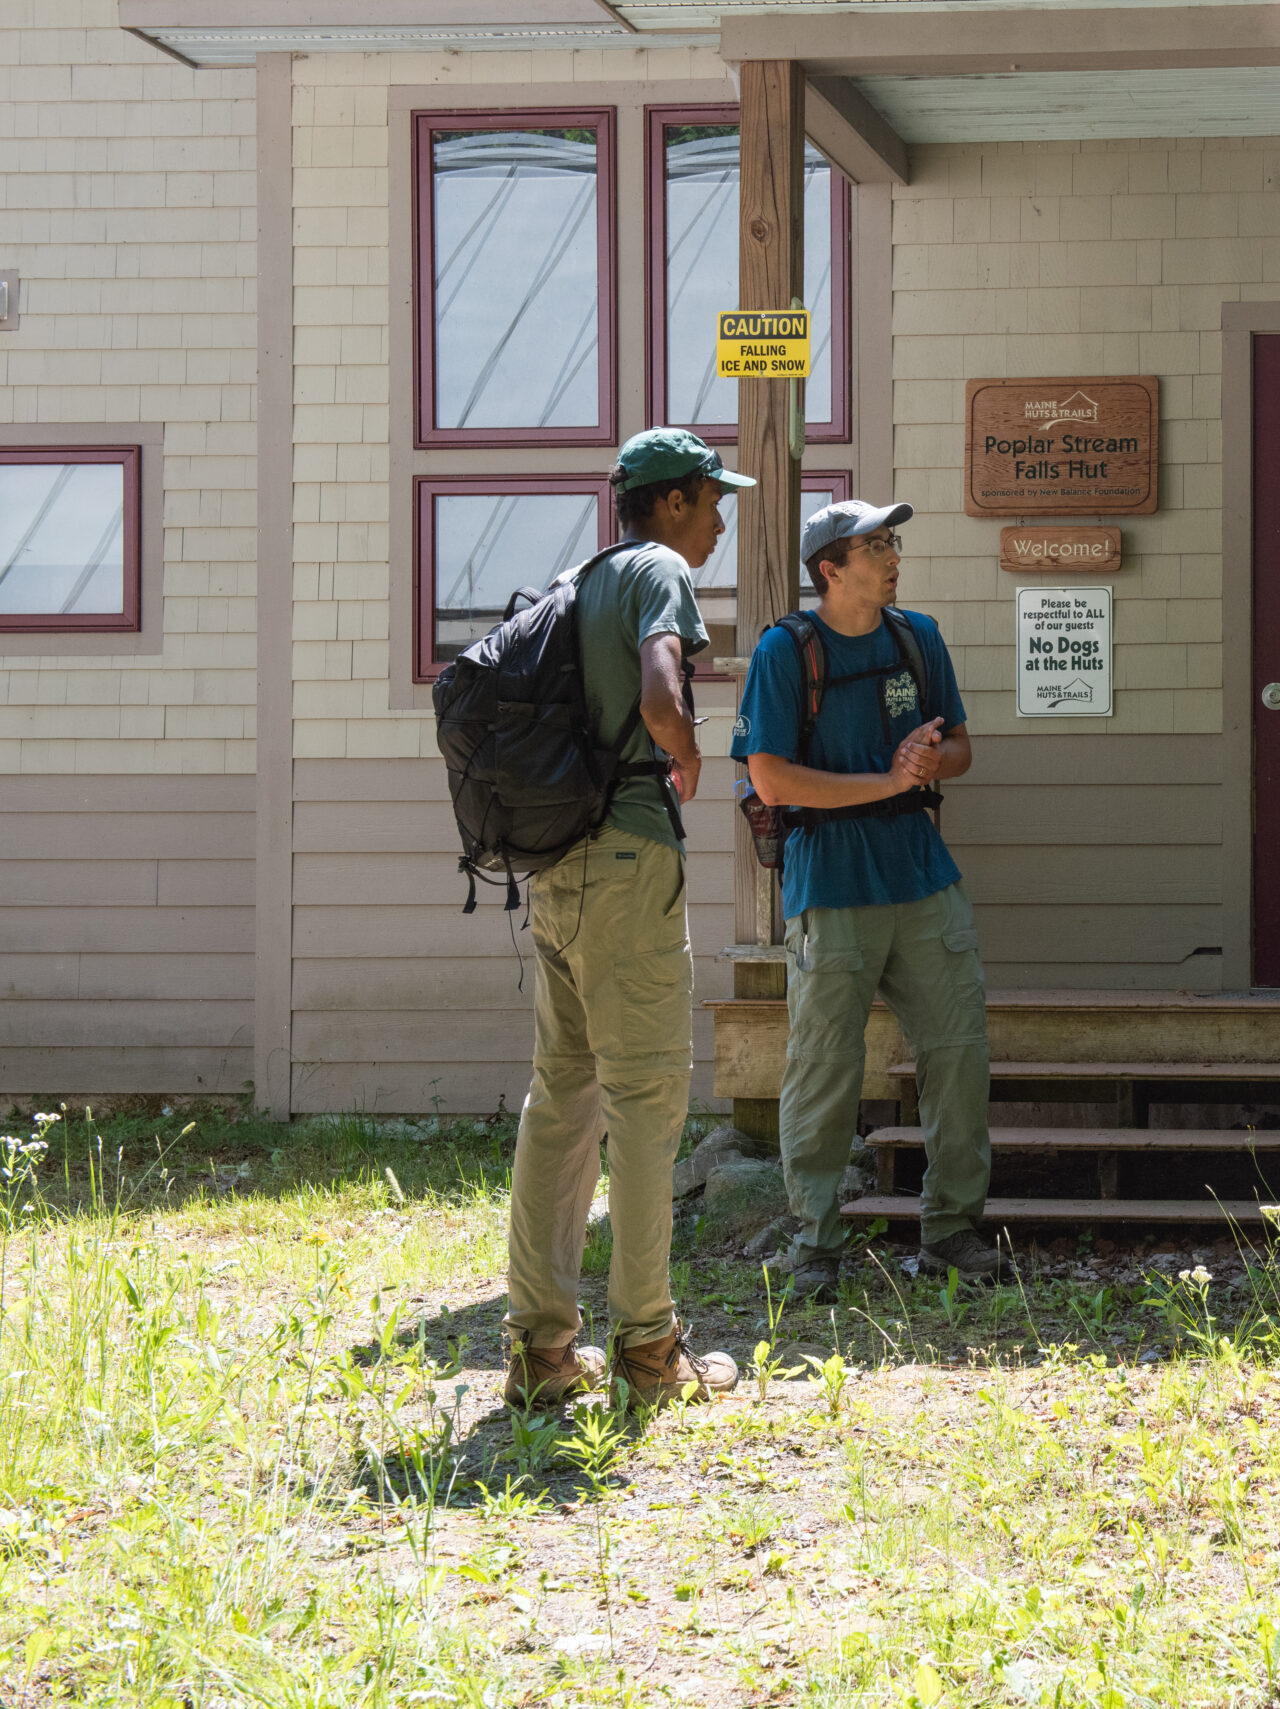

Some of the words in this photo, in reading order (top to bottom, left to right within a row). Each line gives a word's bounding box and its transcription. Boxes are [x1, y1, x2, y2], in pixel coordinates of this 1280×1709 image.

[723, 318, 804, 336] CAUTION
[740, 345, 786, 356] FALLING
[721, 360, 740, 371] ICE
[743, 360, 767, 371] AND
[771, 360, 805, 371] SNOW
[1025, 401, 1057, 409] MAINE
[985, 435, 1055, 458] Poplar
[1062, 435, 1138, 453] Stream
[1015, 460, 1060, 479] Falls
[1069, 460, 1107, 479] Hut
[981, 488, 1025, 497] sponsored
[1027, 488, 1037, 497] by
[1040, 488, 1058, 496] New
[1061, 487, 1092, 496] Balance
[1094, 487, 1141, 496] Foundation
[1013, 539, 1109, 557] Welcome!
[1041, 599, 1071, 608] Please
[1074, 598, 1087, 608] be
[1023, 609, 1070, 621] respectful
[1073, 610, 1083, 619] to
[1086, 608, 1105, 618] ALL
[1034, 621, 1045, 630] of
[1046, 622, 1063, 630] our
[1065, 621, 1094, 632] guests
[1029, 636, 1053, 654] No
[1058, 636, 1099, 657] Dogs
[1025, 657, 1040, 671] at
[1043, 655, 1067, 671] the
[1071, 655, 1104, 671] Huts
[886, 688, 916, 697] MAINE
